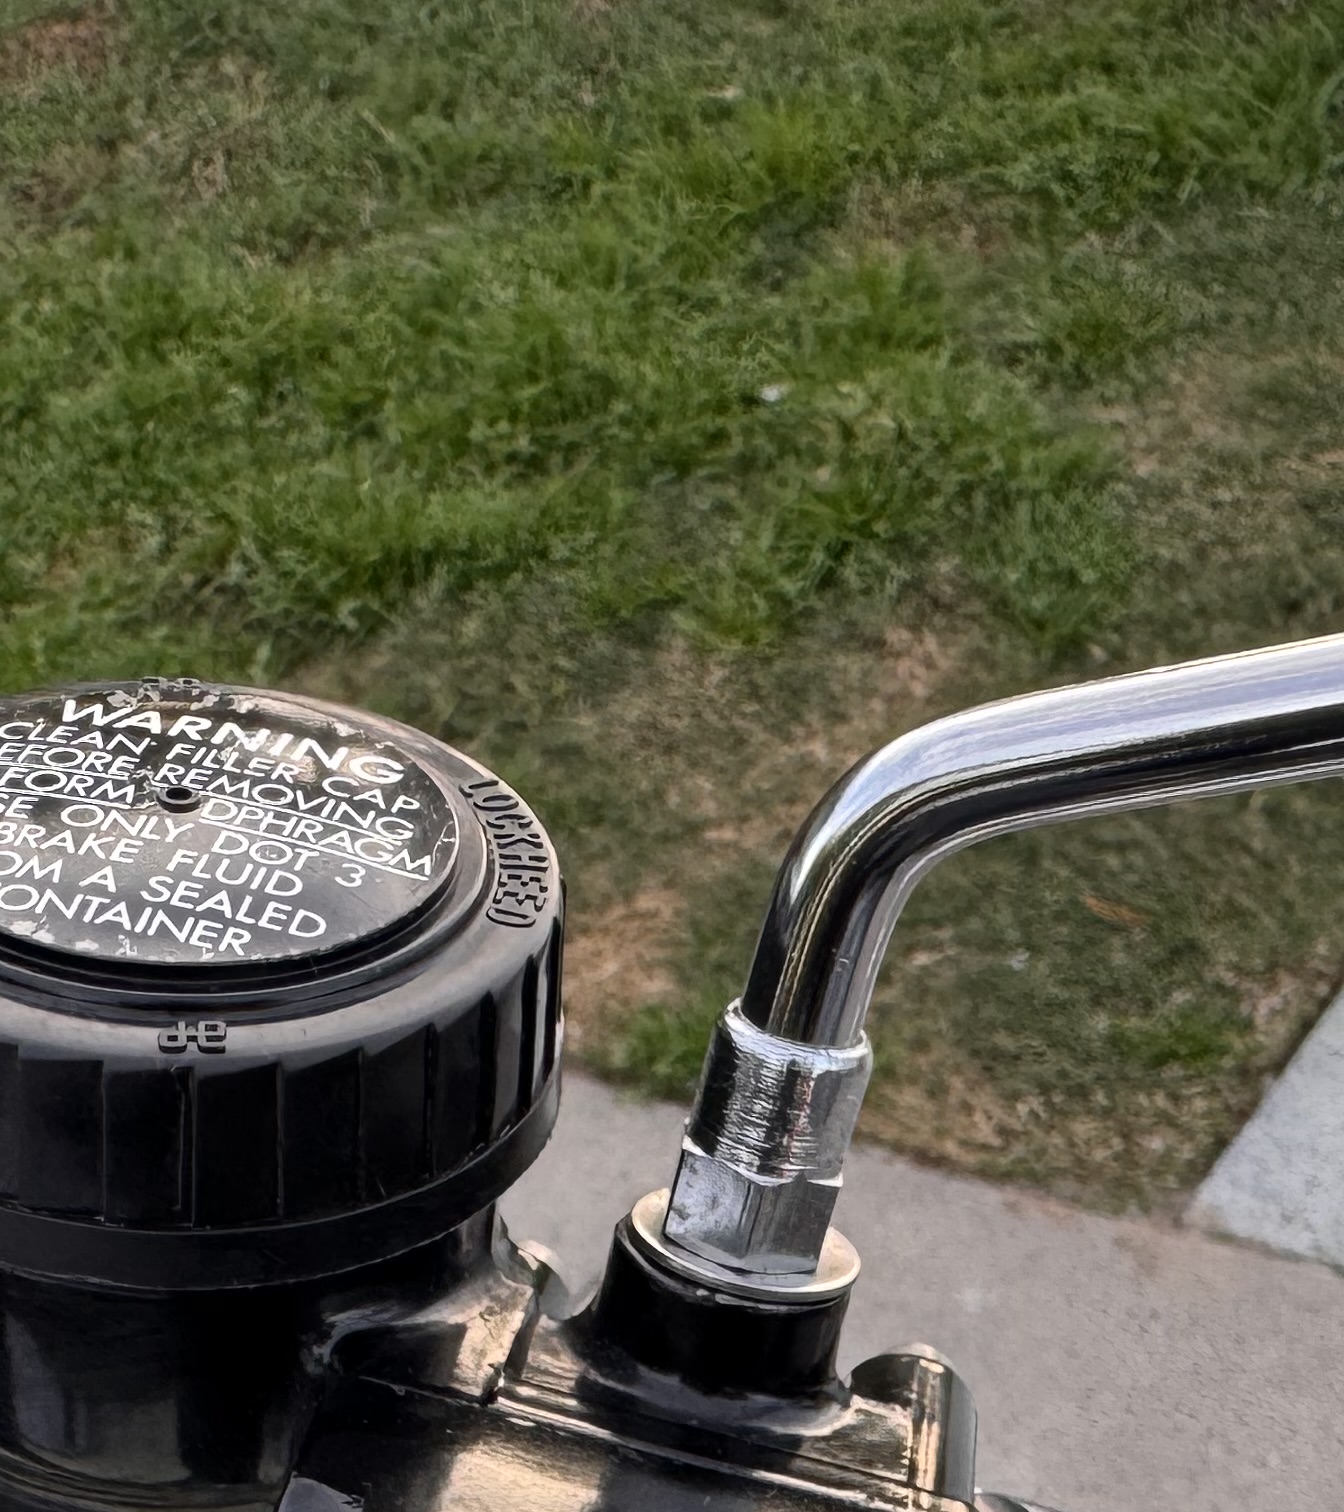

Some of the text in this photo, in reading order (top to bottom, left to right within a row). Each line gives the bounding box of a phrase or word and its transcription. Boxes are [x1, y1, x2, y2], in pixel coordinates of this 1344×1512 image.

[62, 699, 404, 784] WARNING
[166, 743, 299, 783] FILLER
[322, 776, 421, 814] CAP
[154, 764, 415, 840] REMOVING
[201, 798, 432, 876] DPHRAGM
[60, 804, 195, 843] ONLY
[211, 830, 320, 871] DOT
[334, 863, 366, 888] 3
[166, 849, 304, 897] FLUID
[458, 779, 549, 928] LOCKHEED
[79, 865, 117, 892] A
[140, 875, 327, 938] SEALED
